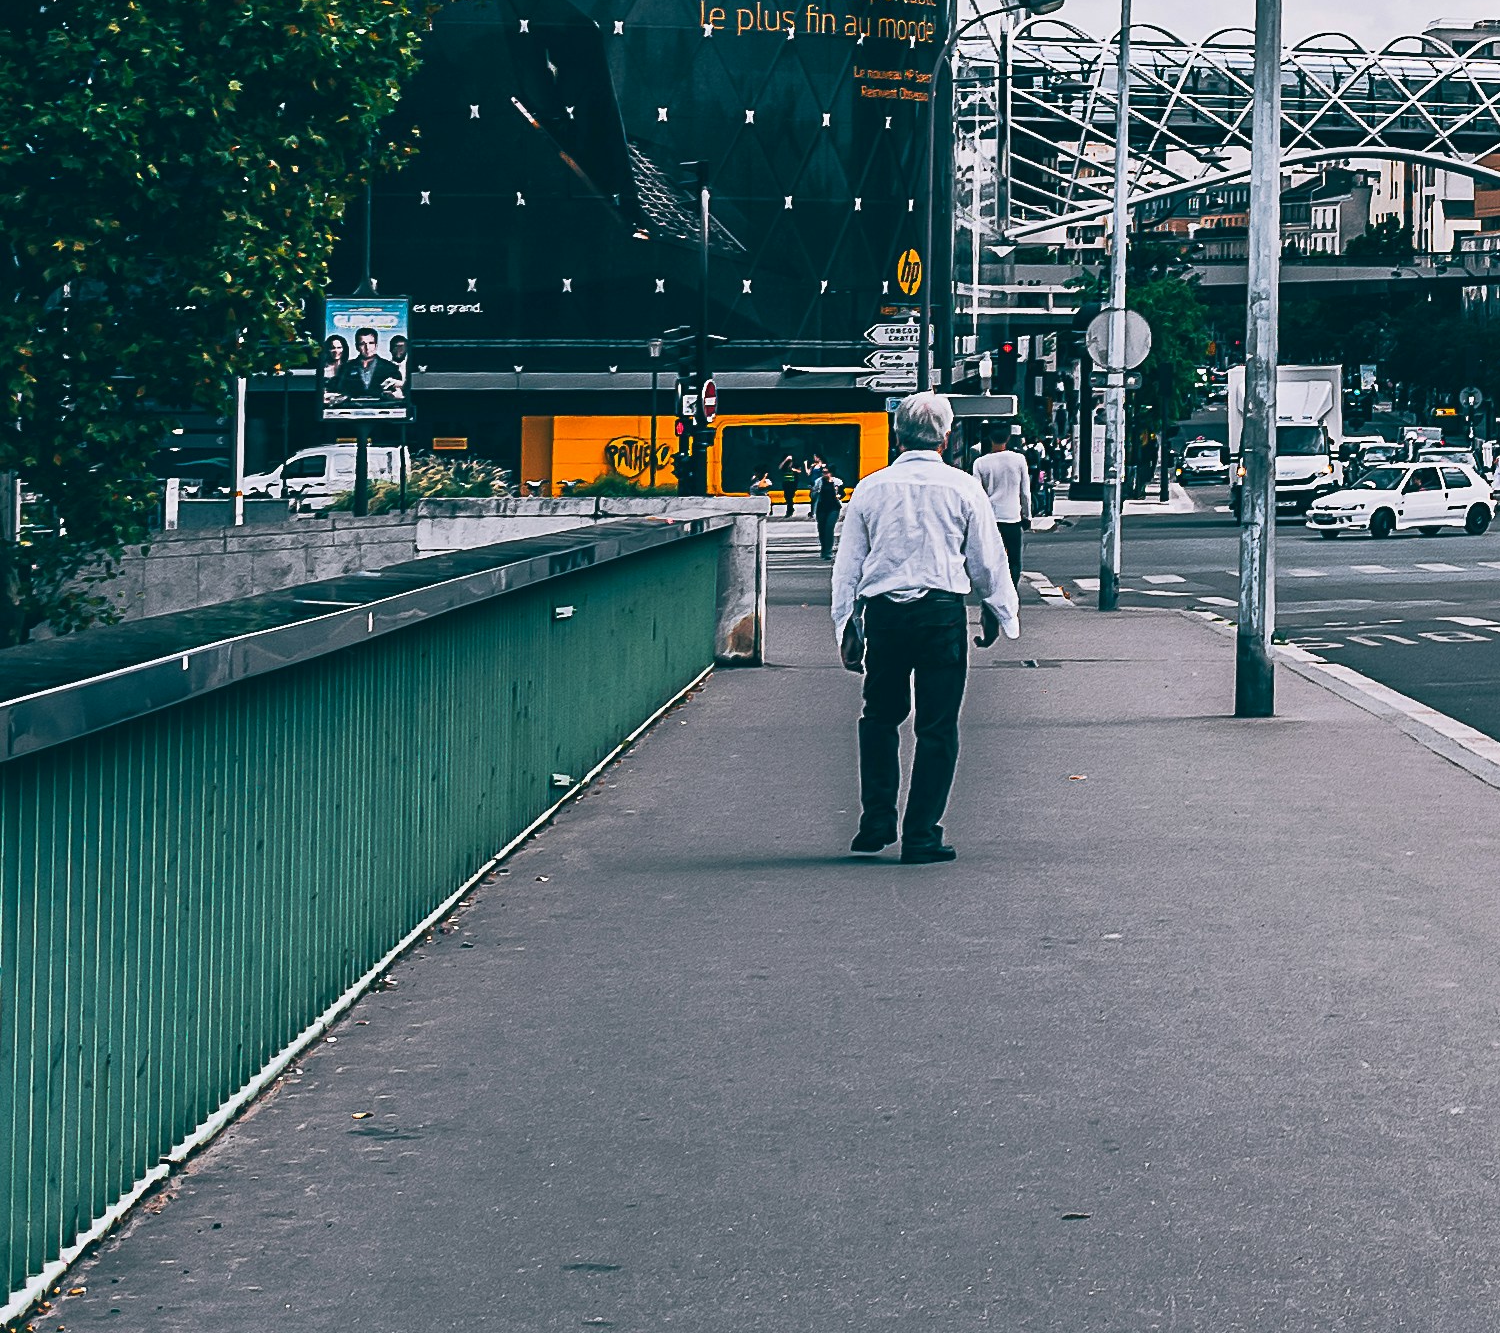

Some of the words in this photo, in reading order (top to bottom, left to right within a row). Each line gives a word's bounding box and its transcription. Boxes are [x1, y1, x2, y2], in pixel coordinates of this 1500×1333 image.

[700, 0, 726, 30] le
[737, 1, 795, 36] plus
[806, 4, 836, 33] fin
[845, 15, 870, 37] au
[878, 15, 935, 43] monde
[430, 304, 444, 313] en
[447, 302, 483, 315] grand.
